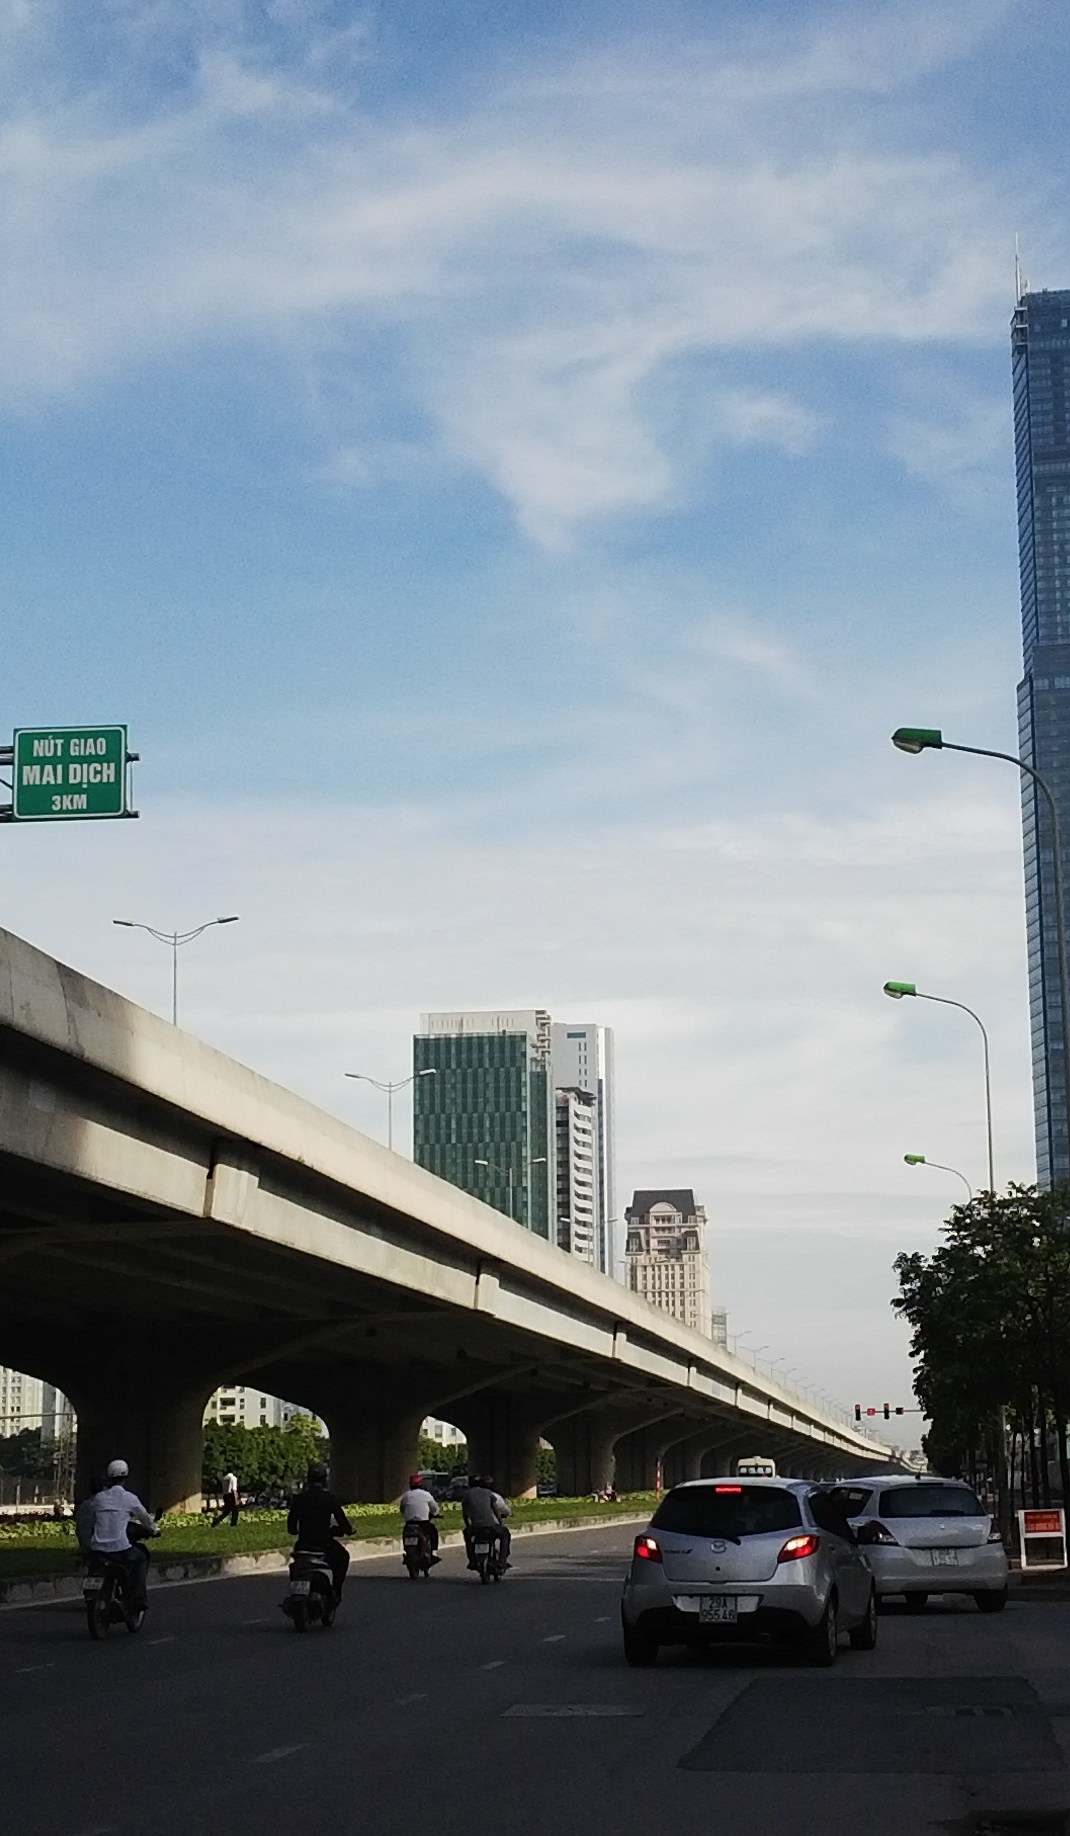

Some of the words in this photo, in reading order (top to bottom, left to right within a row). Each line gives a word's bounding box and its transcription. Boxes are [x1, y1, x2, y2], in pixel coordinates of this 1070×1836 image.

[33, 735, 64, 757] NÚT
[70, 737, 107, 756] GIAO
[22, 764, 63, 785] MAI
[68, 762, 115, 788] DỊCH
[51, 794, 87, 811] 3KM
